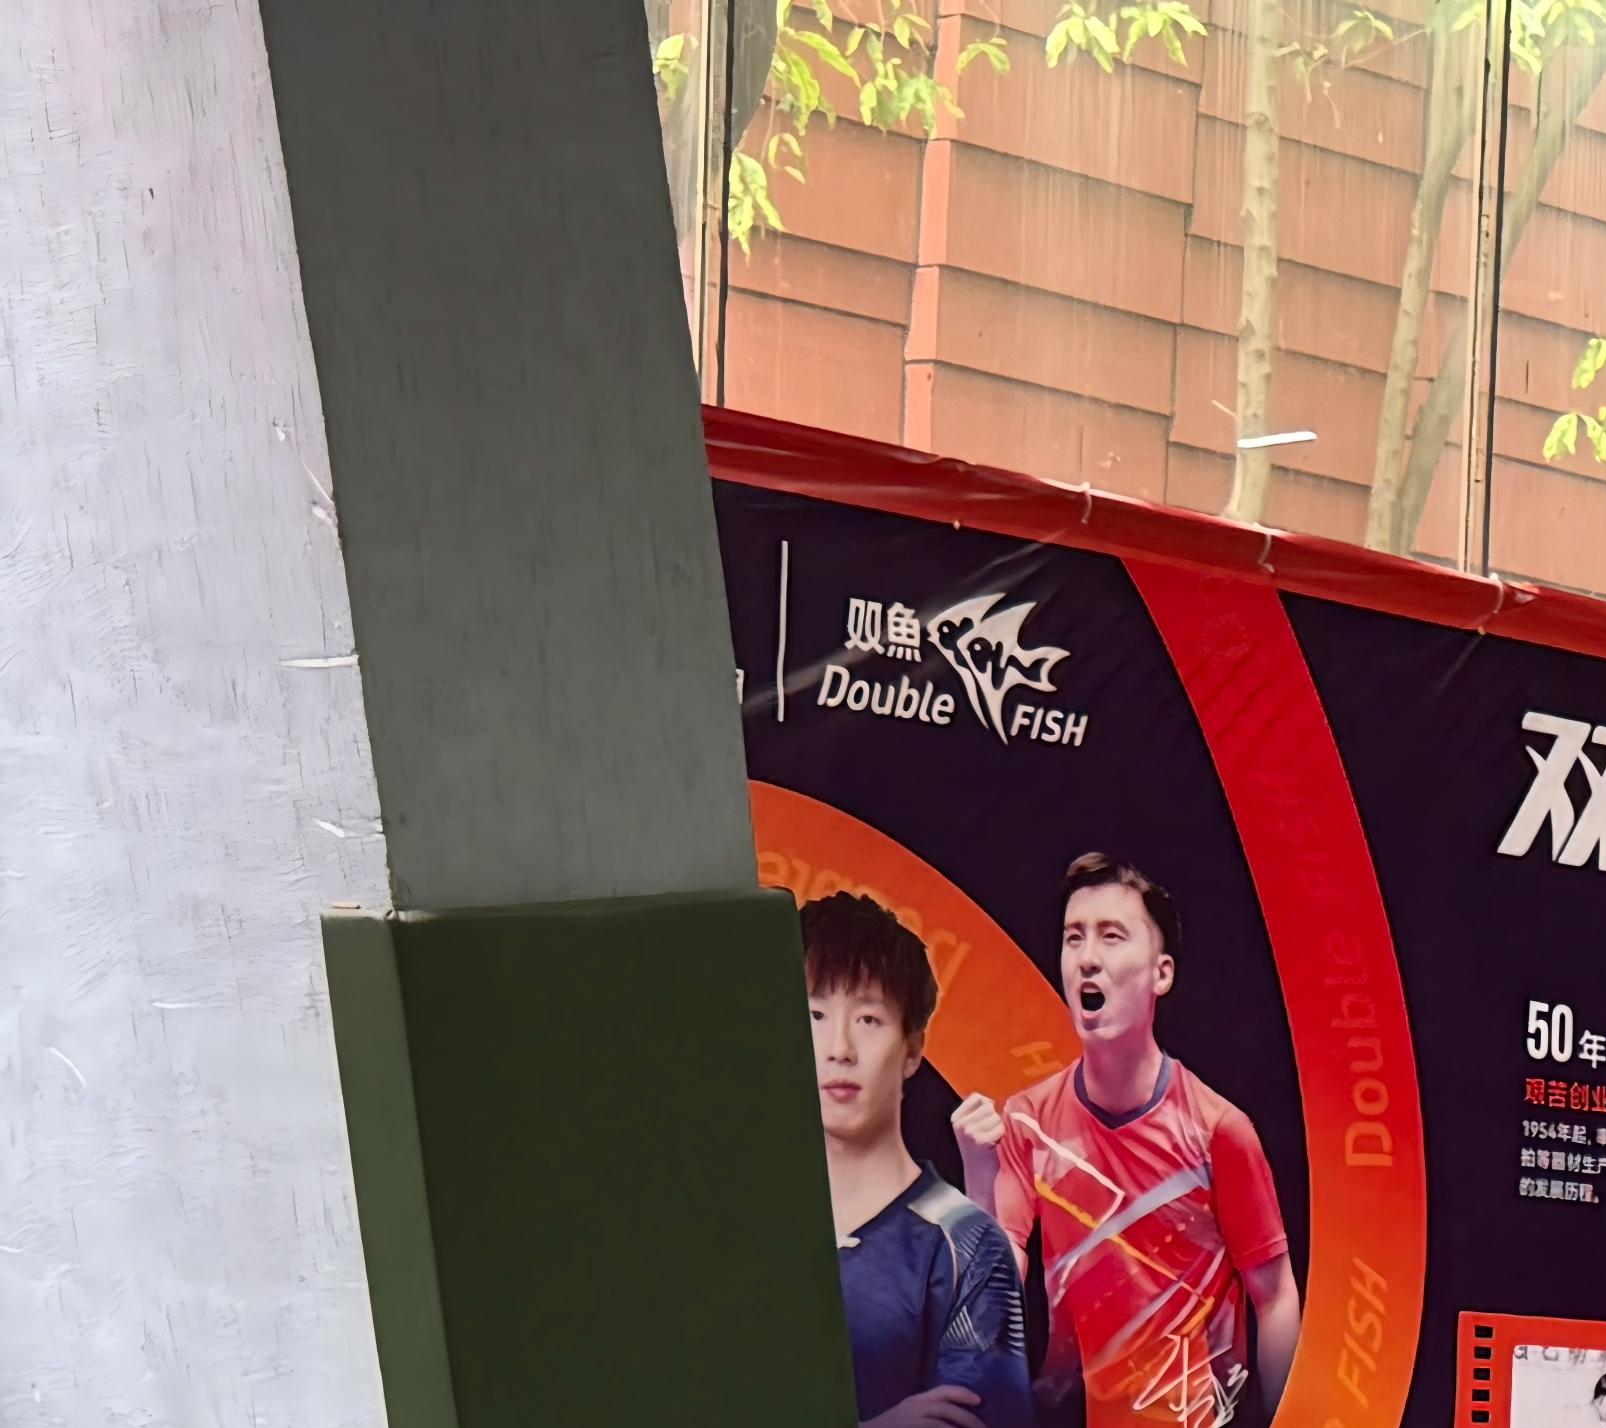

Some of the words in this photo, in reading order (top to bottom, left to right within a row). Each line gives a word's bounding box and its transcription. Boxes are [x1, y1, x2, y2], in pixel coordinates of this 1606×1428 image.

[817, 664, 955, 725] Double
[1010, 704, 1088, 747] FISH
[1323, 928, 1396, 1167] Double
[1336, 1255, 1389, 1410] FISH
